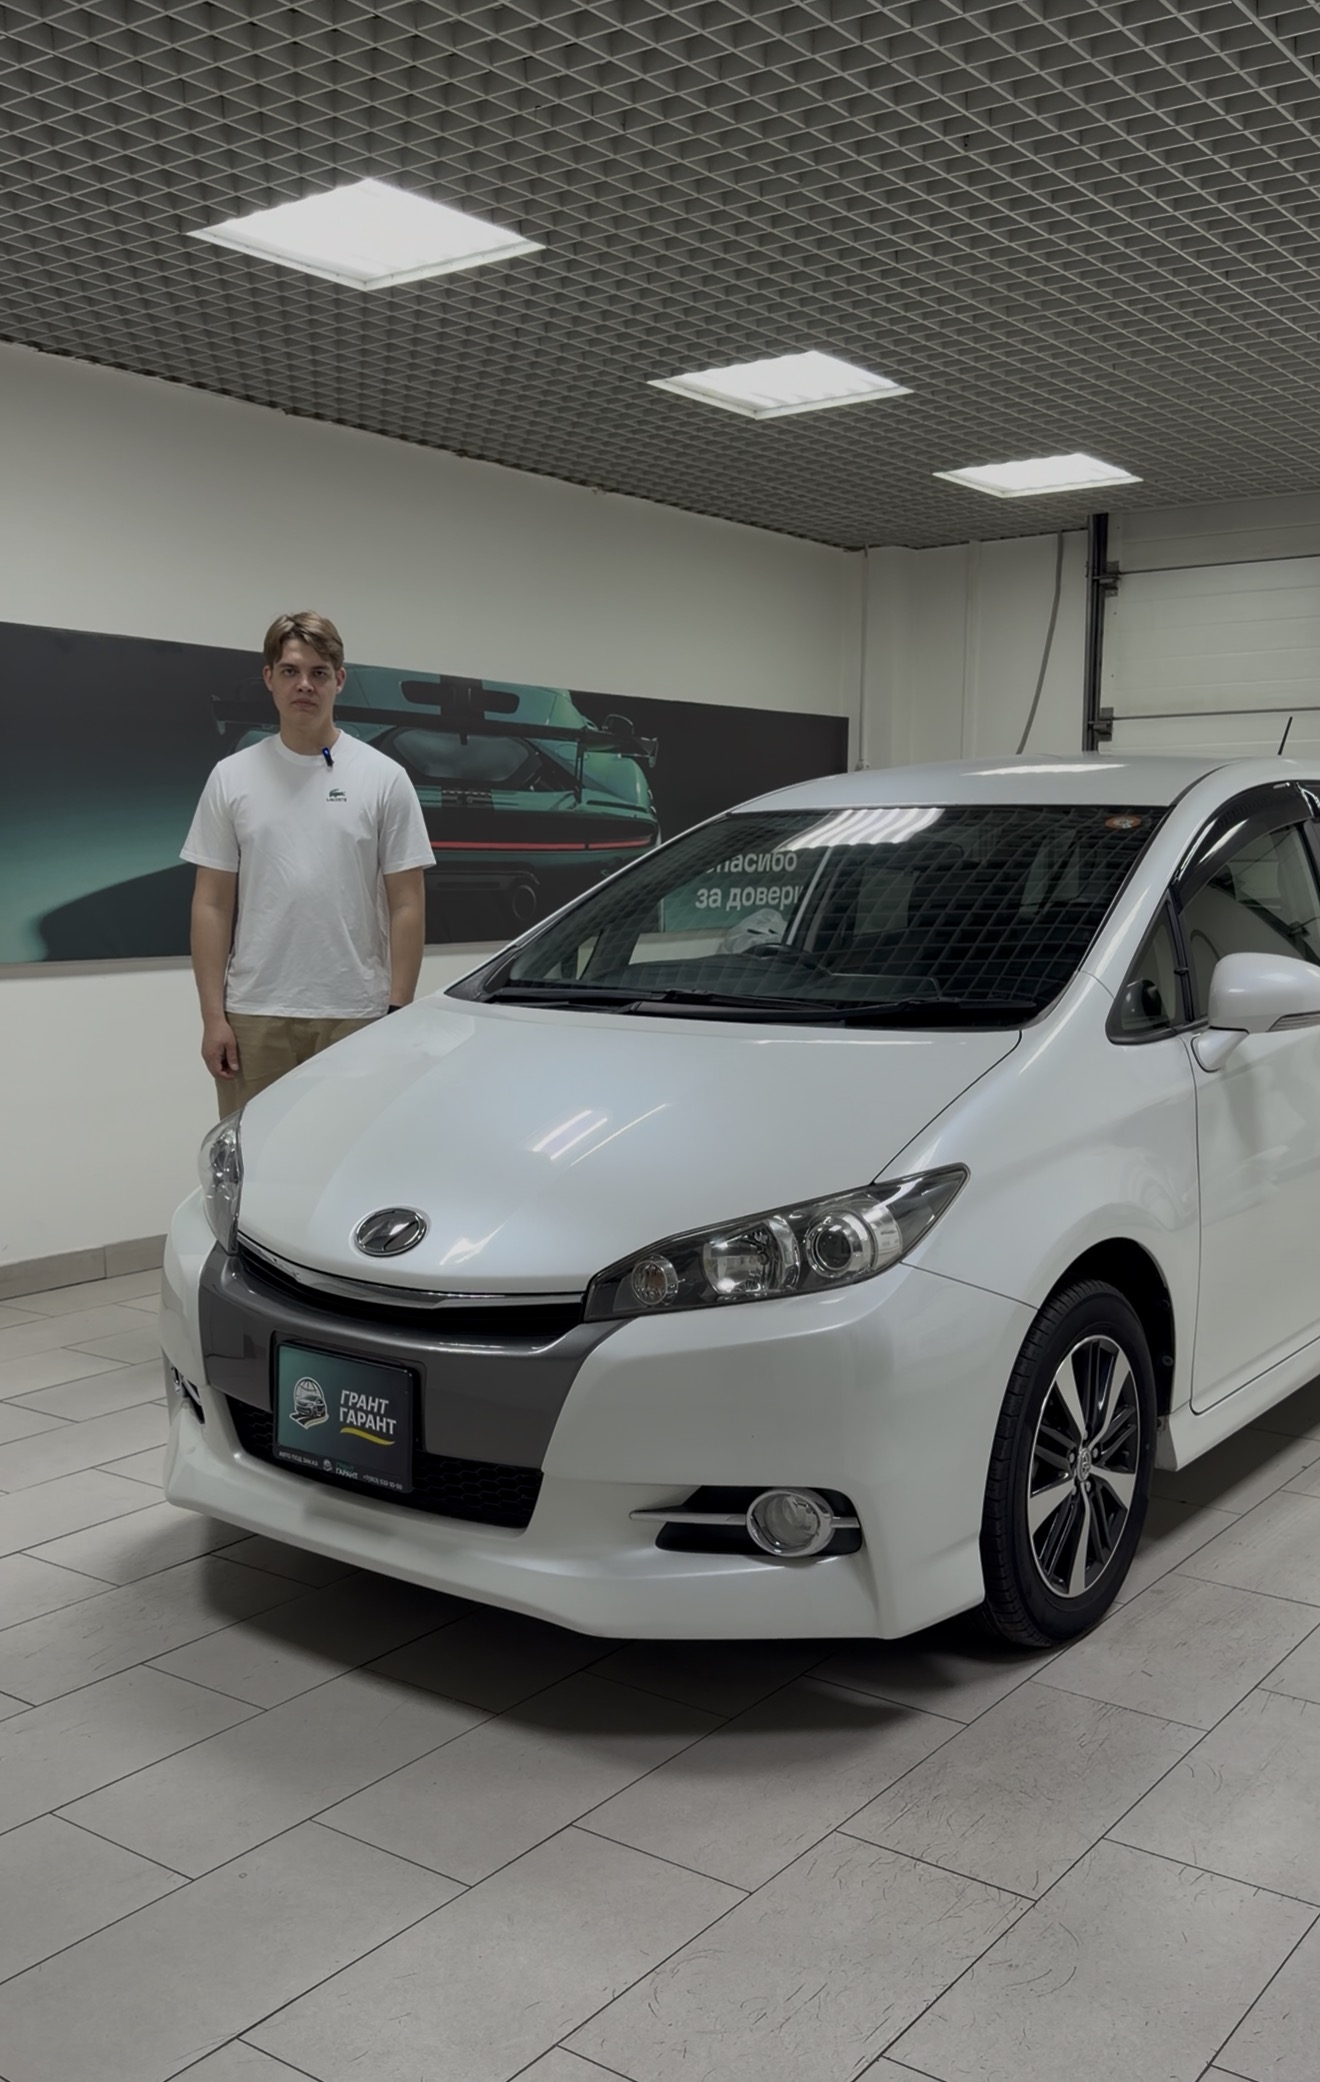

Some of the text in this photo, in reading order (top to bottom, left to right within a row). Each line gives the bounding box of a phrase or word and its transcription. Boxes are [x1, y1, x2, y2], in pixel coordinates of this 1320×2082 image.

[706, 852, 798, 873] асибо
[695, 887, 722, 909] за
[340, 1389, 389, 1415] ГРАНТ
[339, 1407, 397, 1435] ГАРАНТ
[335, 1467, 358, 1480] ГАРАНТ
